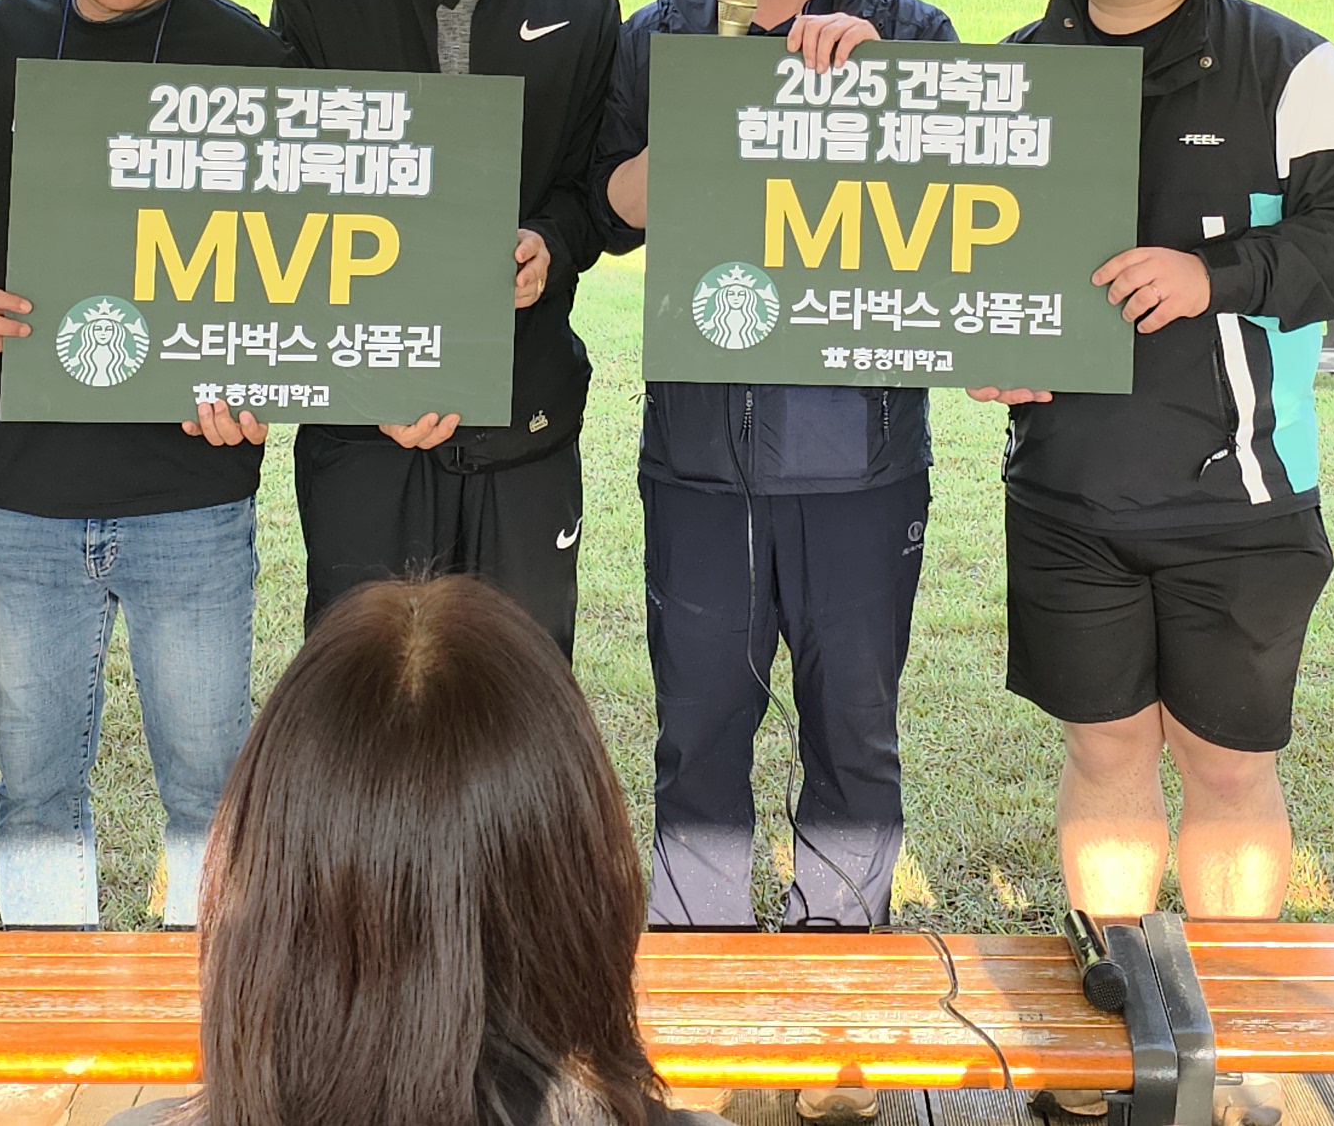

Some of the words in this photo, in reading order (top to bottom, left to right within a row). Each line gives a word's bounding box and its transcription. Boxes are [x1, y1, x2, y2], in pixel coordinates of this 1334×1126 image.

[149, 84, 266, 136] 2025
[276, 87, 411, 141] 건축과
[775, 58, 887, 107] 2025
[897, 59, 1030, 113] 건축과
[738, 107, 870, 161] 한마음
[876, 111, 1051, 167] 체육대회
[108, 135, 247, 191] 한마음
[253, 140, 432, 196] 체육대회
[764, 178, 1021, 273] MVP
[134, 209, 400, 305] MVP
[790, 287, 941, 332] 스타벅스
[950, 291, 1062, 336] 상품권
[160, 321, 318, 367] 스타벅스
[327, 323, 442, 368] 상품권
[852, 347, 954, 372] 충청대학교
[225, 383, 330, 407] 충청대학교
